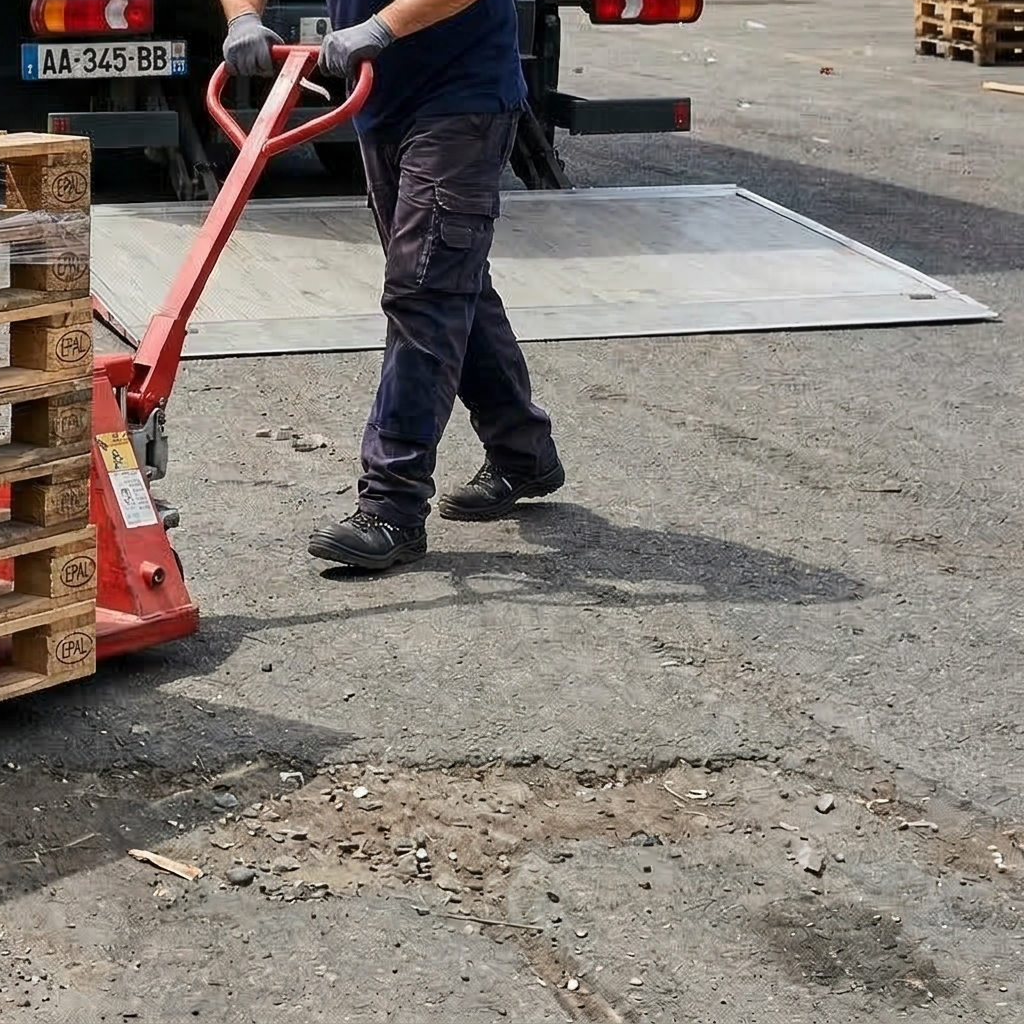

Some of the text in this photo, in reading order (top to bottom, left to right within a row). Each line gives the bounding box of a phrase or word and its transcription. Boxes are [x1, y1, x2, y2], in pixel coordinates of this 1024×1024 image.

[42, 46, 167, 75] AA-345-BB
[65, 562, 89, 583] EPAL
[62, 637, 87, 659] EPAL
